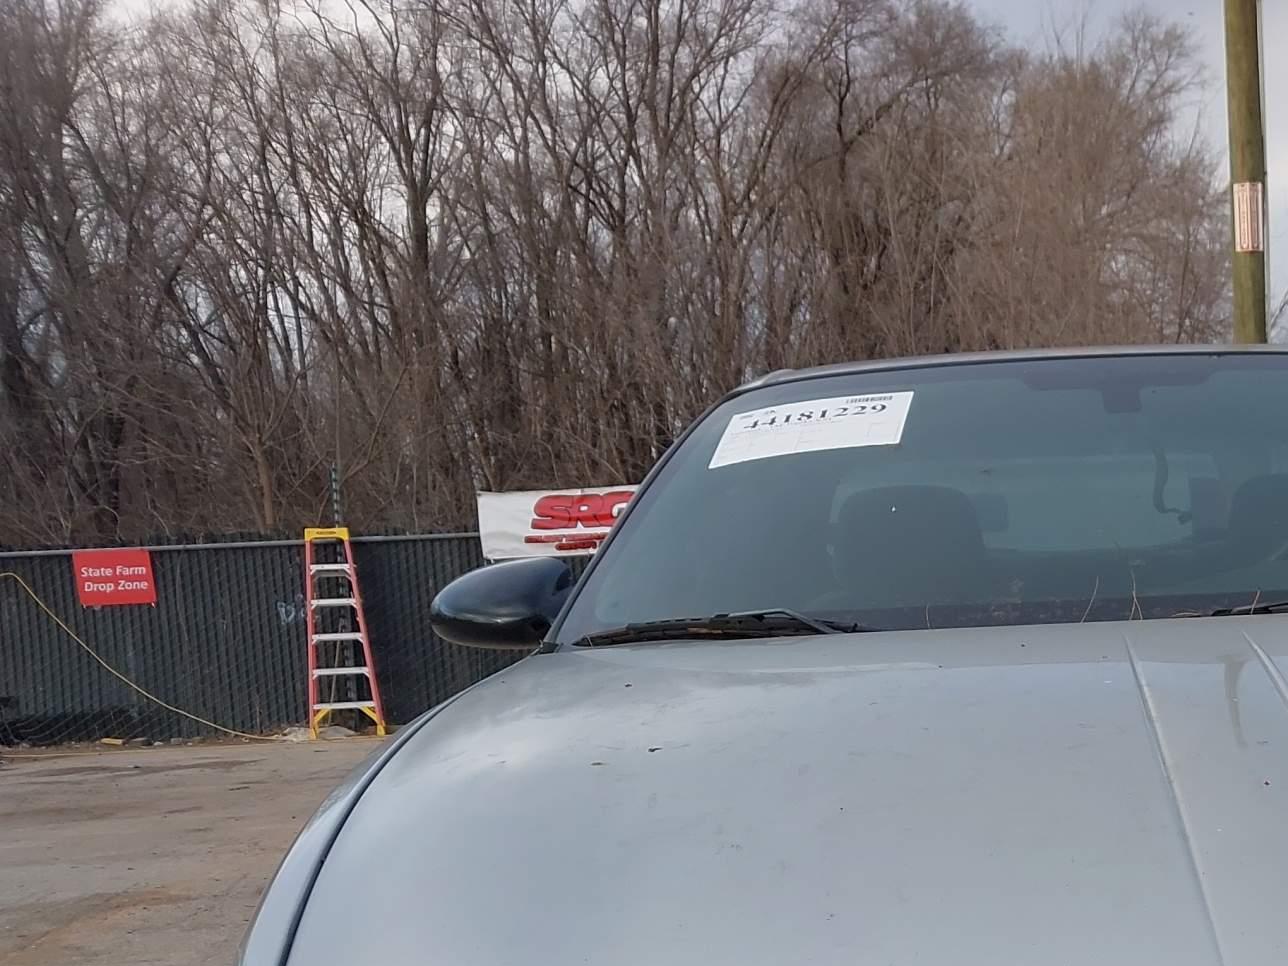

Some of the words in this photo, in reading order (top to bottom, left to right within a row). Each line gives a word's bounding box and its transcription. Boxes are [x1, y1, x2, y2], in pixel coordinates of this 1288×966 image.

[743, 403, 888, 429] 44181229
[80, 566, 113, 577] State
[115, 565, 147, 576] Farm
[84, 581, 115, 593] Drop
[117, 580, 149, 591] Zone
